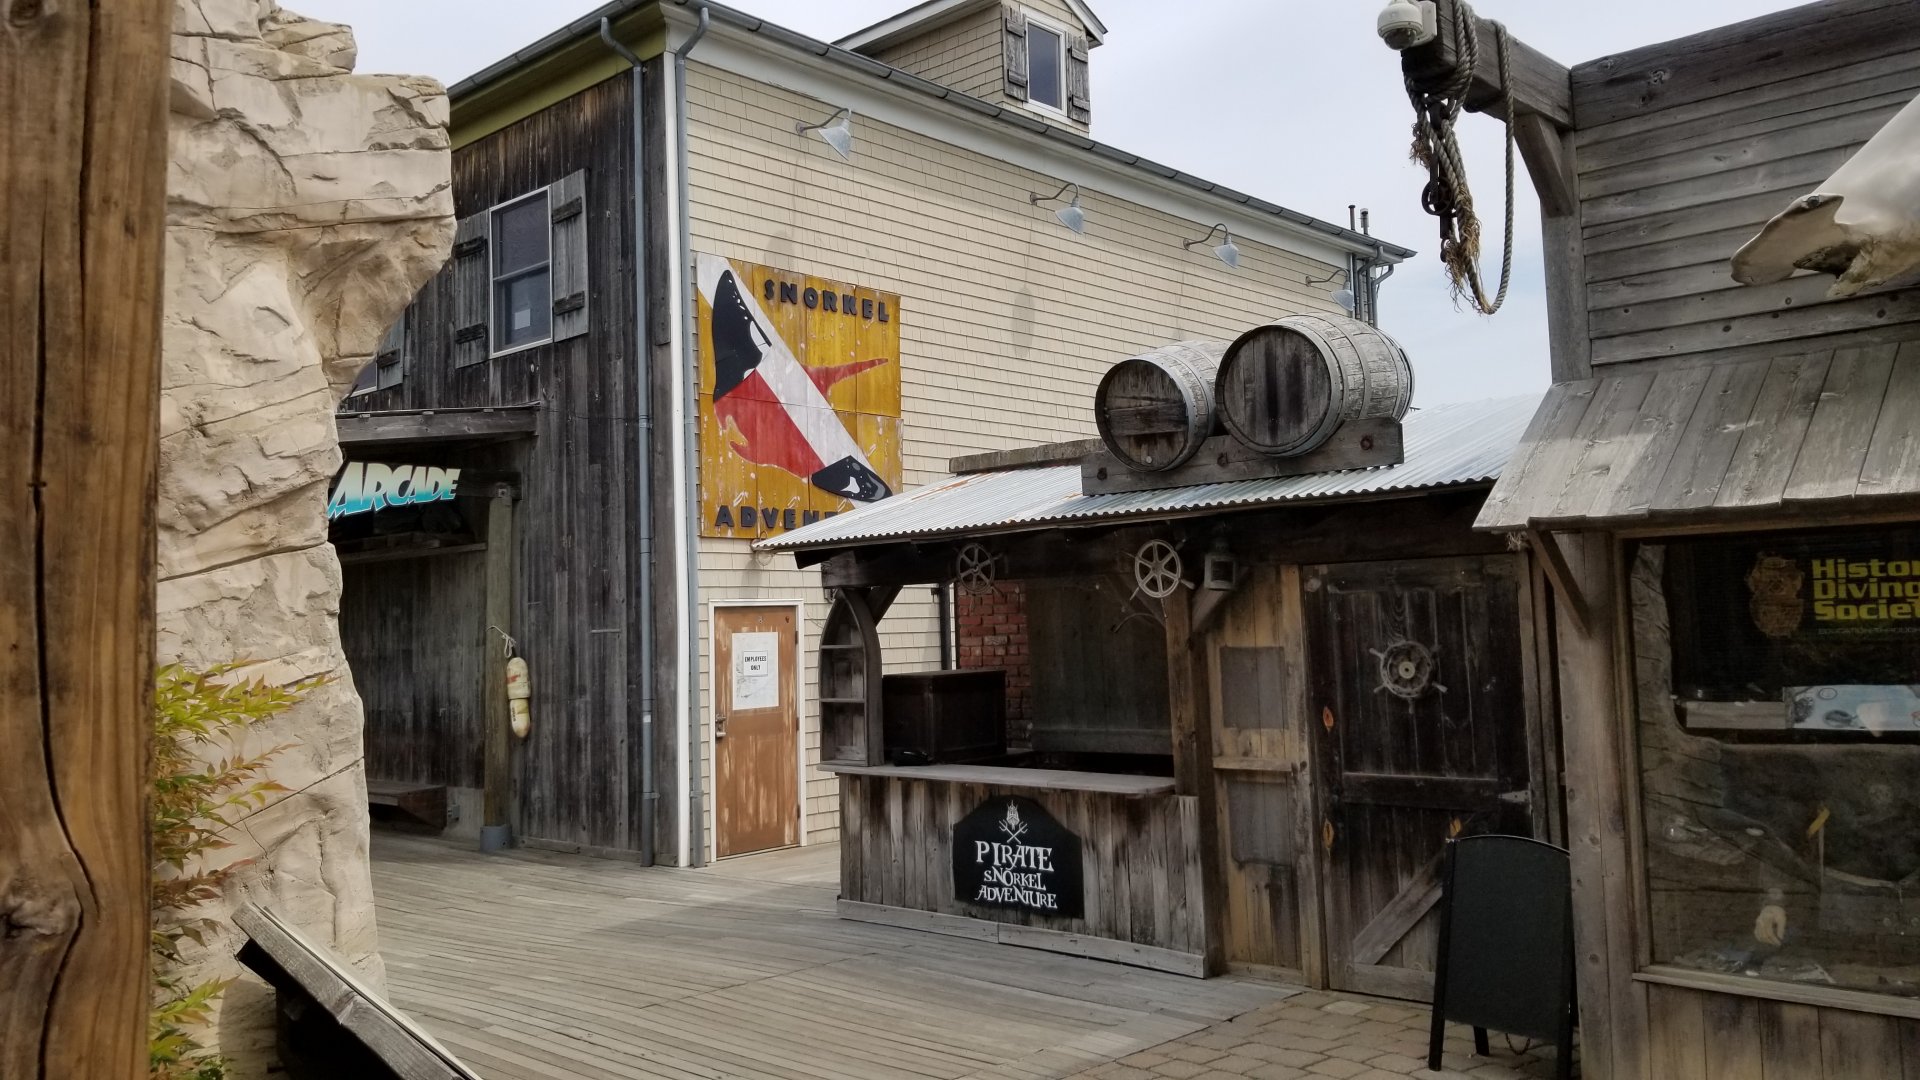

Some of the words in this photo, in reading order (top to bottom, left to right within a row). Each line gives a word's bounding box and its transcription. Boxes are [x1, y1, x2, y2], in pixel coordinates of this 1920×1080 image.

[764, 279, 889, 323] SNORKEL
[327, 461, 461, 521] ARCADE
[715, 505, 838, 530] ADVEN
[744, 655, 767, 663] EMPLOYEES
[974, 840, 1055, 872] PIRATE
[974, 885, 1058, 909] ADVENTURE
